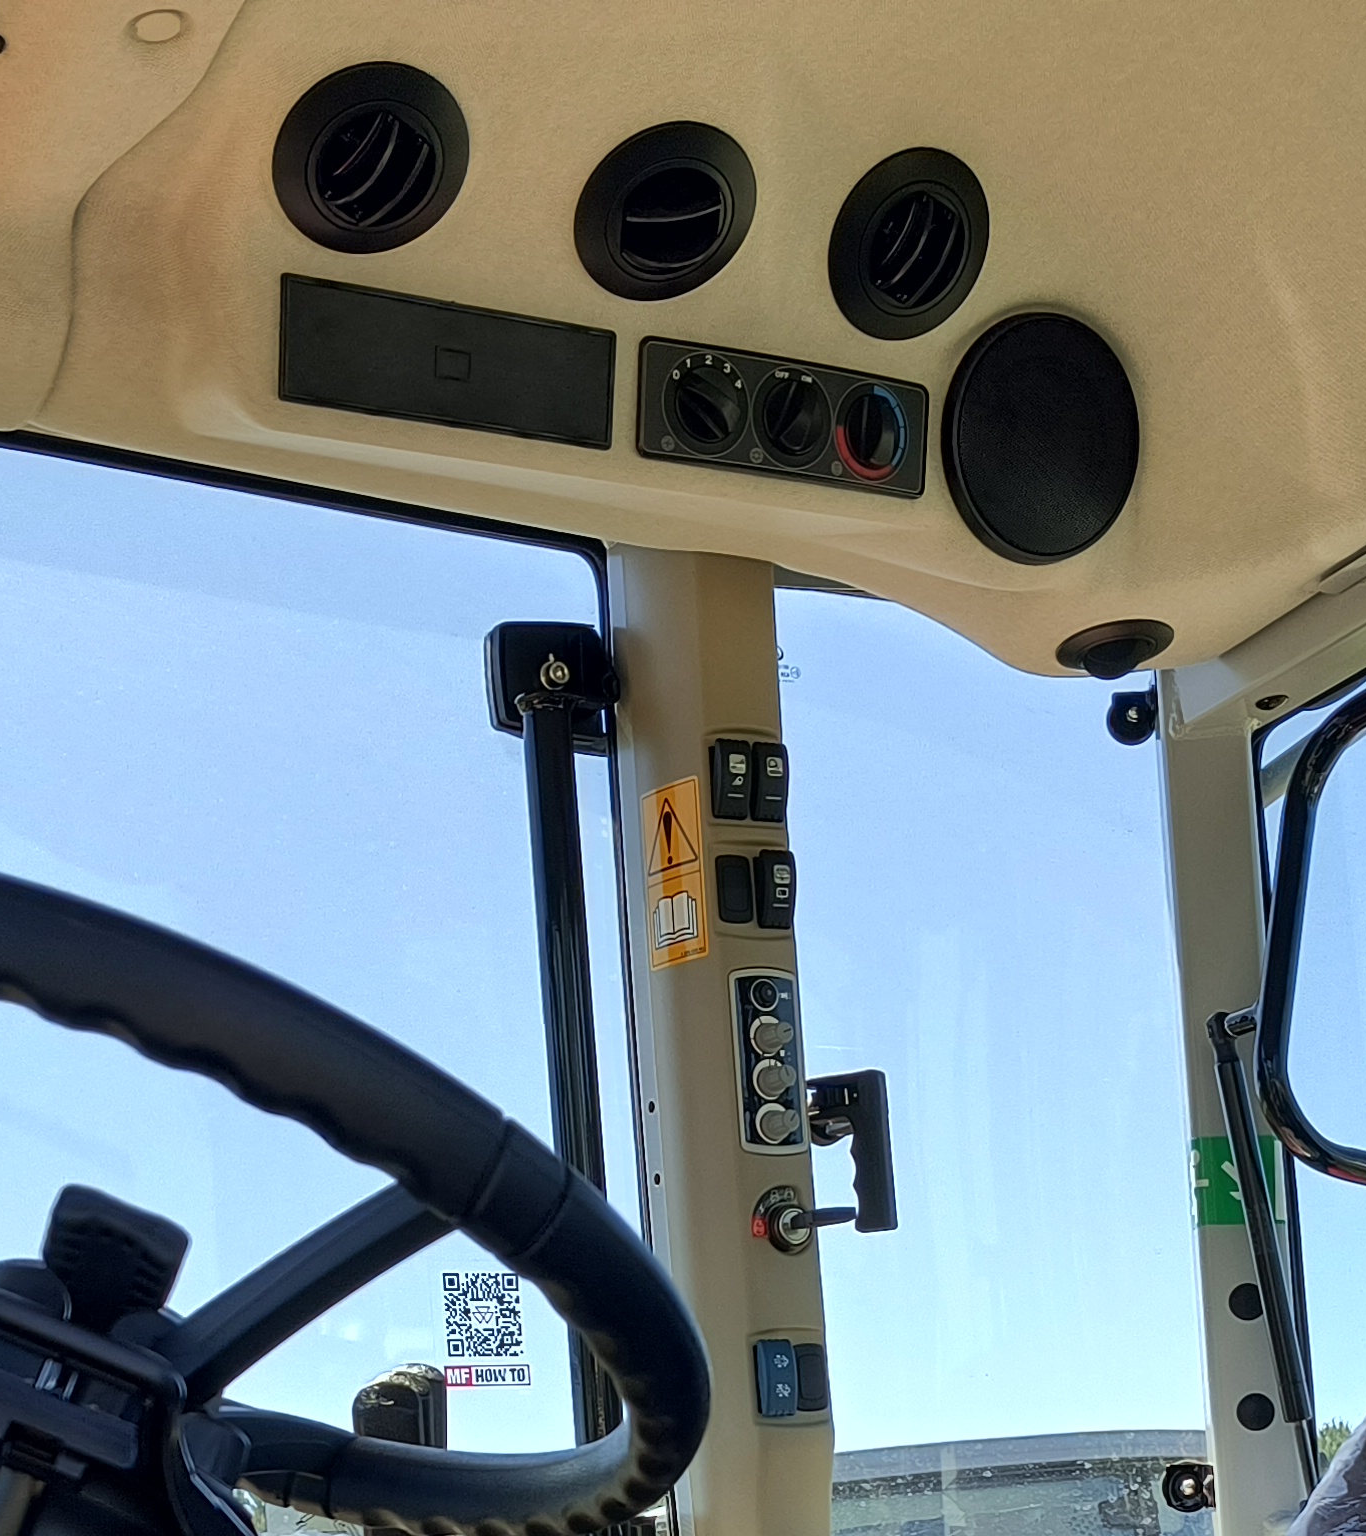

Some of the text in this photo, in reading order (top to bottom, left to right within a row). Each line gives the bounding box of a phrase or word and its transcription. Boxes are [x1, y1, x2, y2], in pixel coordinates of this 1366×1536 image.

[686, 358, 691, 368] 1
[704, 355, 713, 365] 2
[723, 363, 731, 373] 3
[735, 379, 742, 389] 4
[446, 1368, 526, 1384] MF HOW TO
